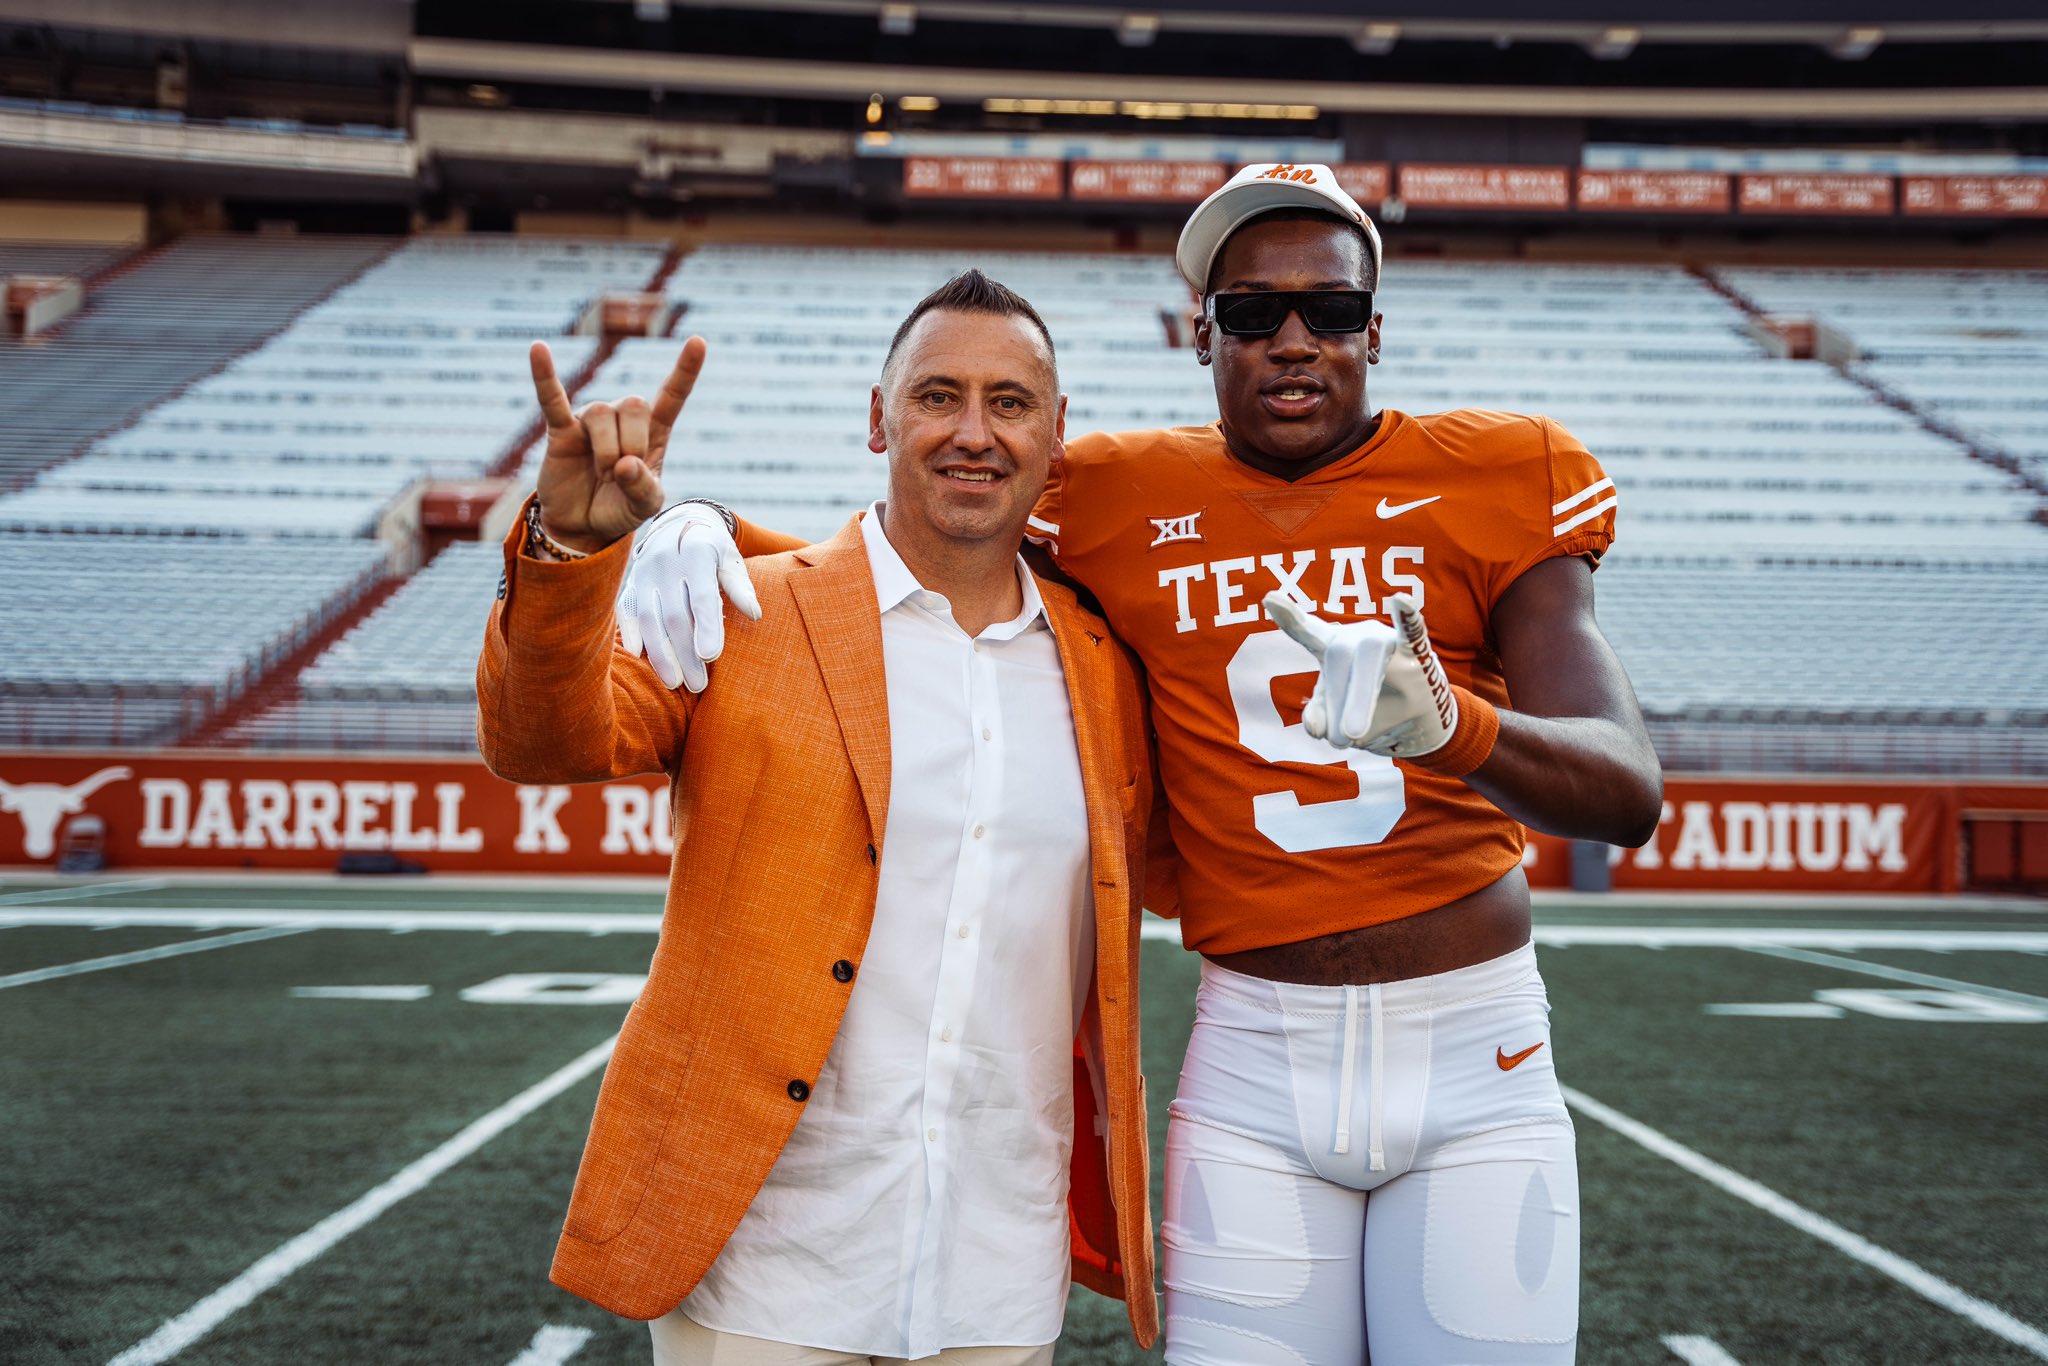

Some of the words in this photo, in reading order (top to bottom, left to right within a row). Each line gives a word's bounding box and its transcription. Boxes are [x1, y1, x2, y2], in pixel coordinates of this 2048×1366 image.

[1158, 546, 1425, 633] TEXAS
[138, 778, 484, 852] DARRELL
[514, 784, 571, 854] K
[1607, 801, 1907, 872] TADIUM
